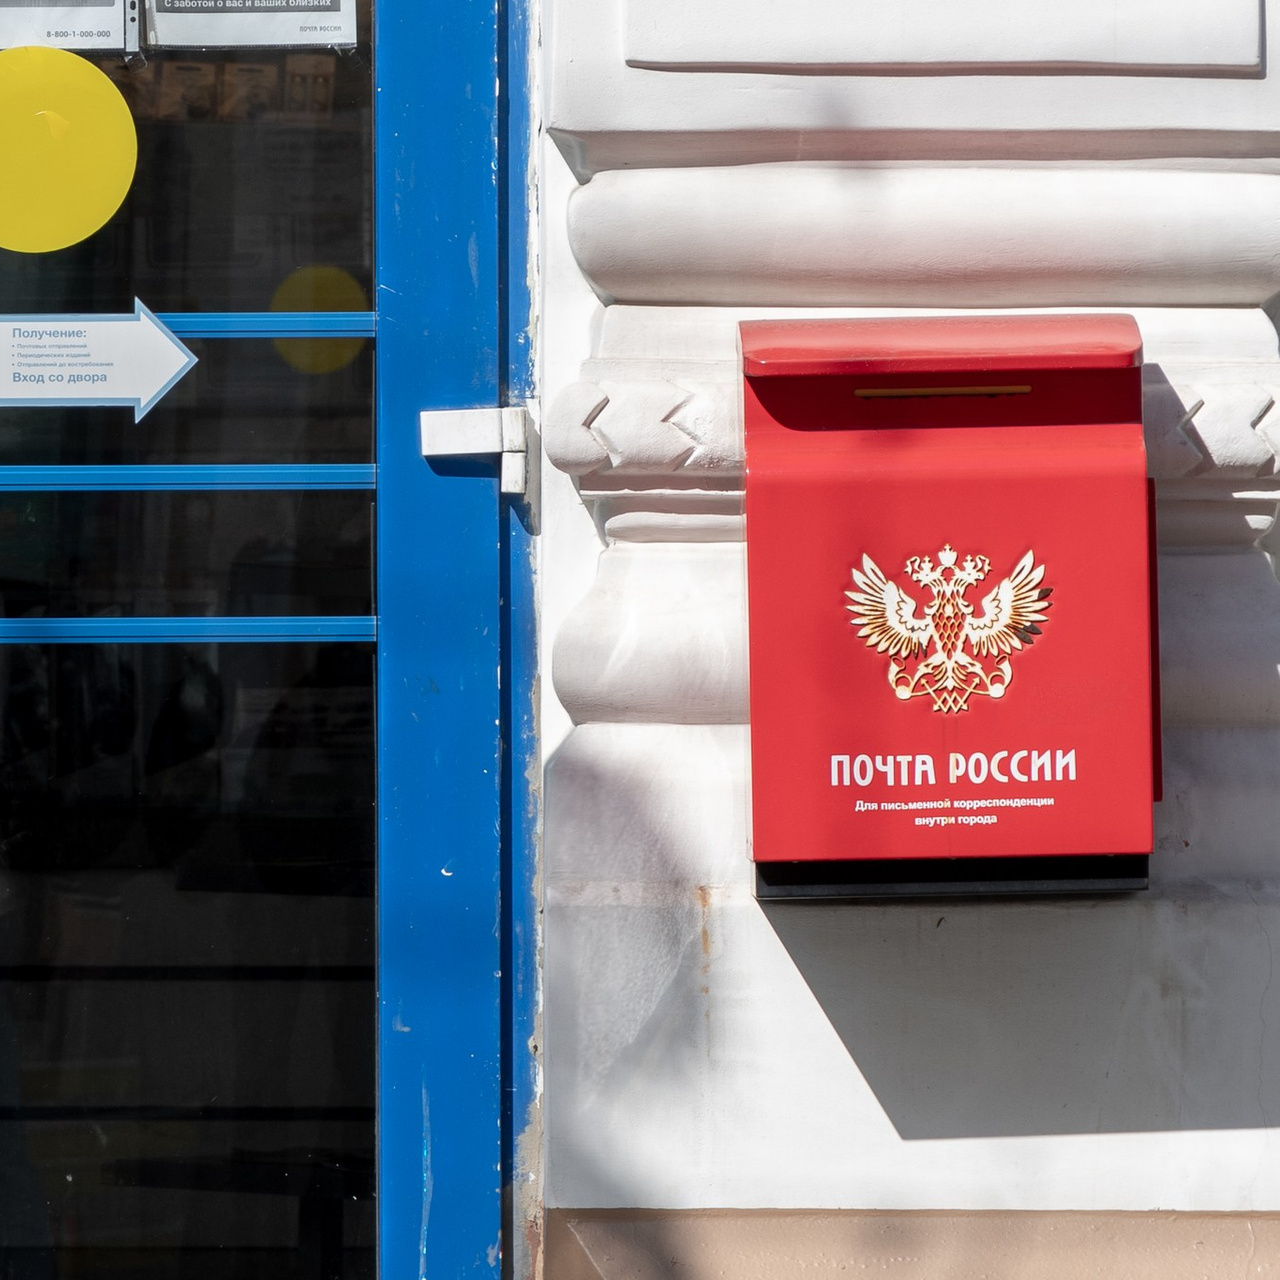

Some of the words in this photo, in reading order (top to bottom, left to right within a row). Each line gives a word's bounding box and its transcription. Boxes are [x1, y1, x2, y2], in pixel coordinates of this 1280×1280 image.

[254, 0, 287, 7] ваших
[46, 30, 111, 38] 8-800-1-000-000
[12, 328, 86, 340] Получение:
[13, 372, 45, 384] Вход
[48, 374, 64, 382] со
[67, 374, 107, 384] двора
[831, 754, 936, 786] ПОЧТА
[949, 749, 1076, 784] РОССИИ
[855, 800, 878, 812] Для
[880, 799, 951, 810] письменной
[953, 798, 1054, 810] корреспонденции
[915, 817, 955, 827] внутри
[957, 815, 997, 826] города
